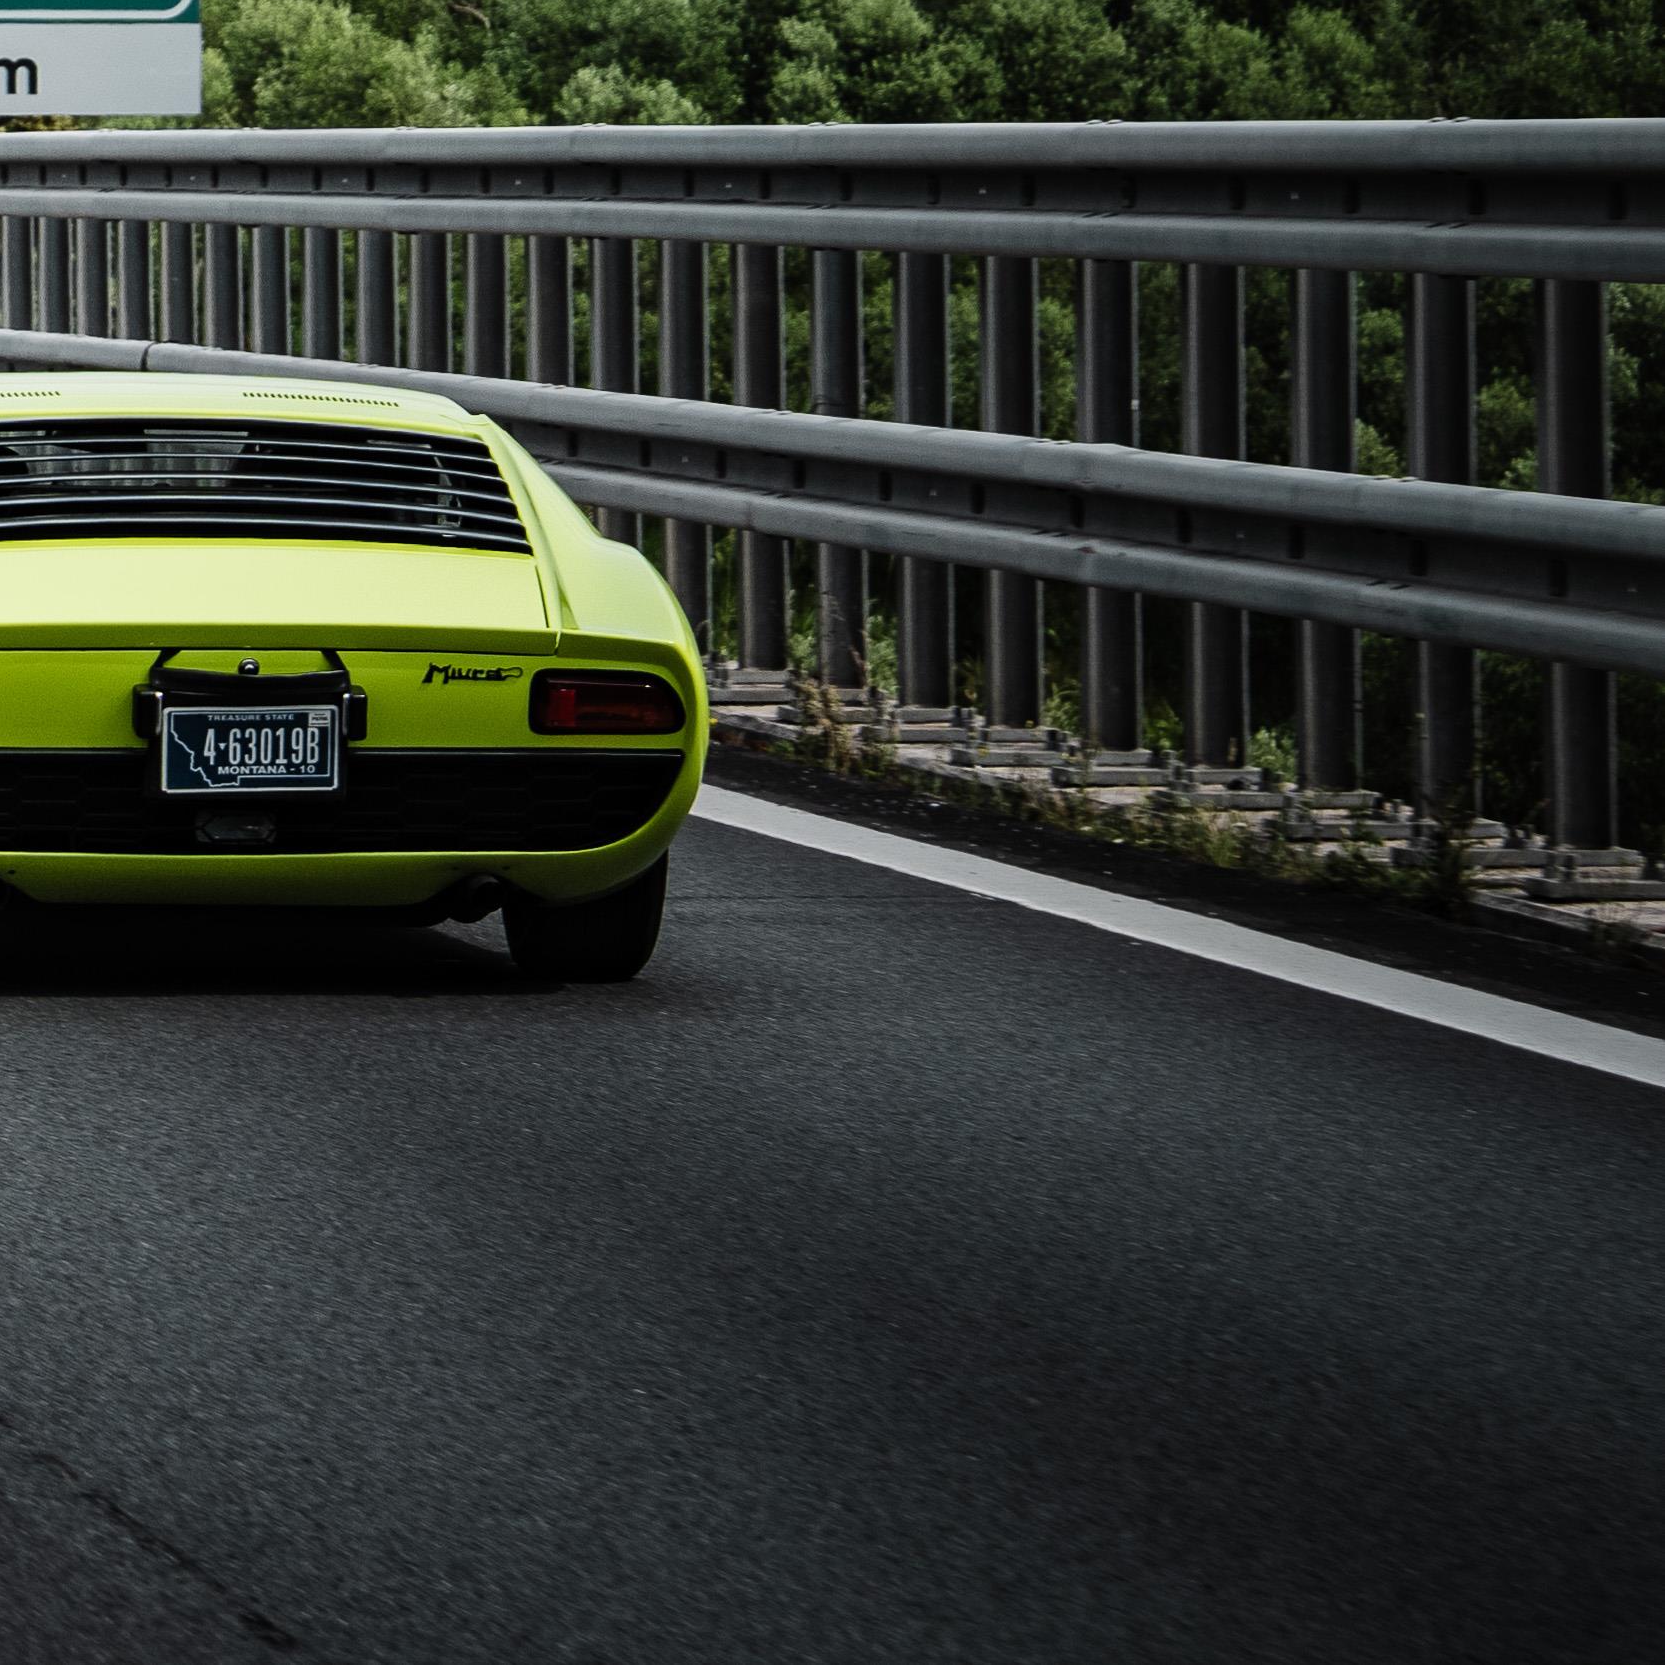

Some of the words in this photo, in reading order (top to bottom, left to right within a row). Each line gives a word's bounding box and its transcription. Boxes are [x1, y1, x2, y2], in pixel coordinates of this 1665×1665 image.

[207, 714, 261, 722] TREASURE
[264, 713, 294, 721] STATE
[217, 765, 287, 776] MONTANA
[299, 764, 316, 774] 10
